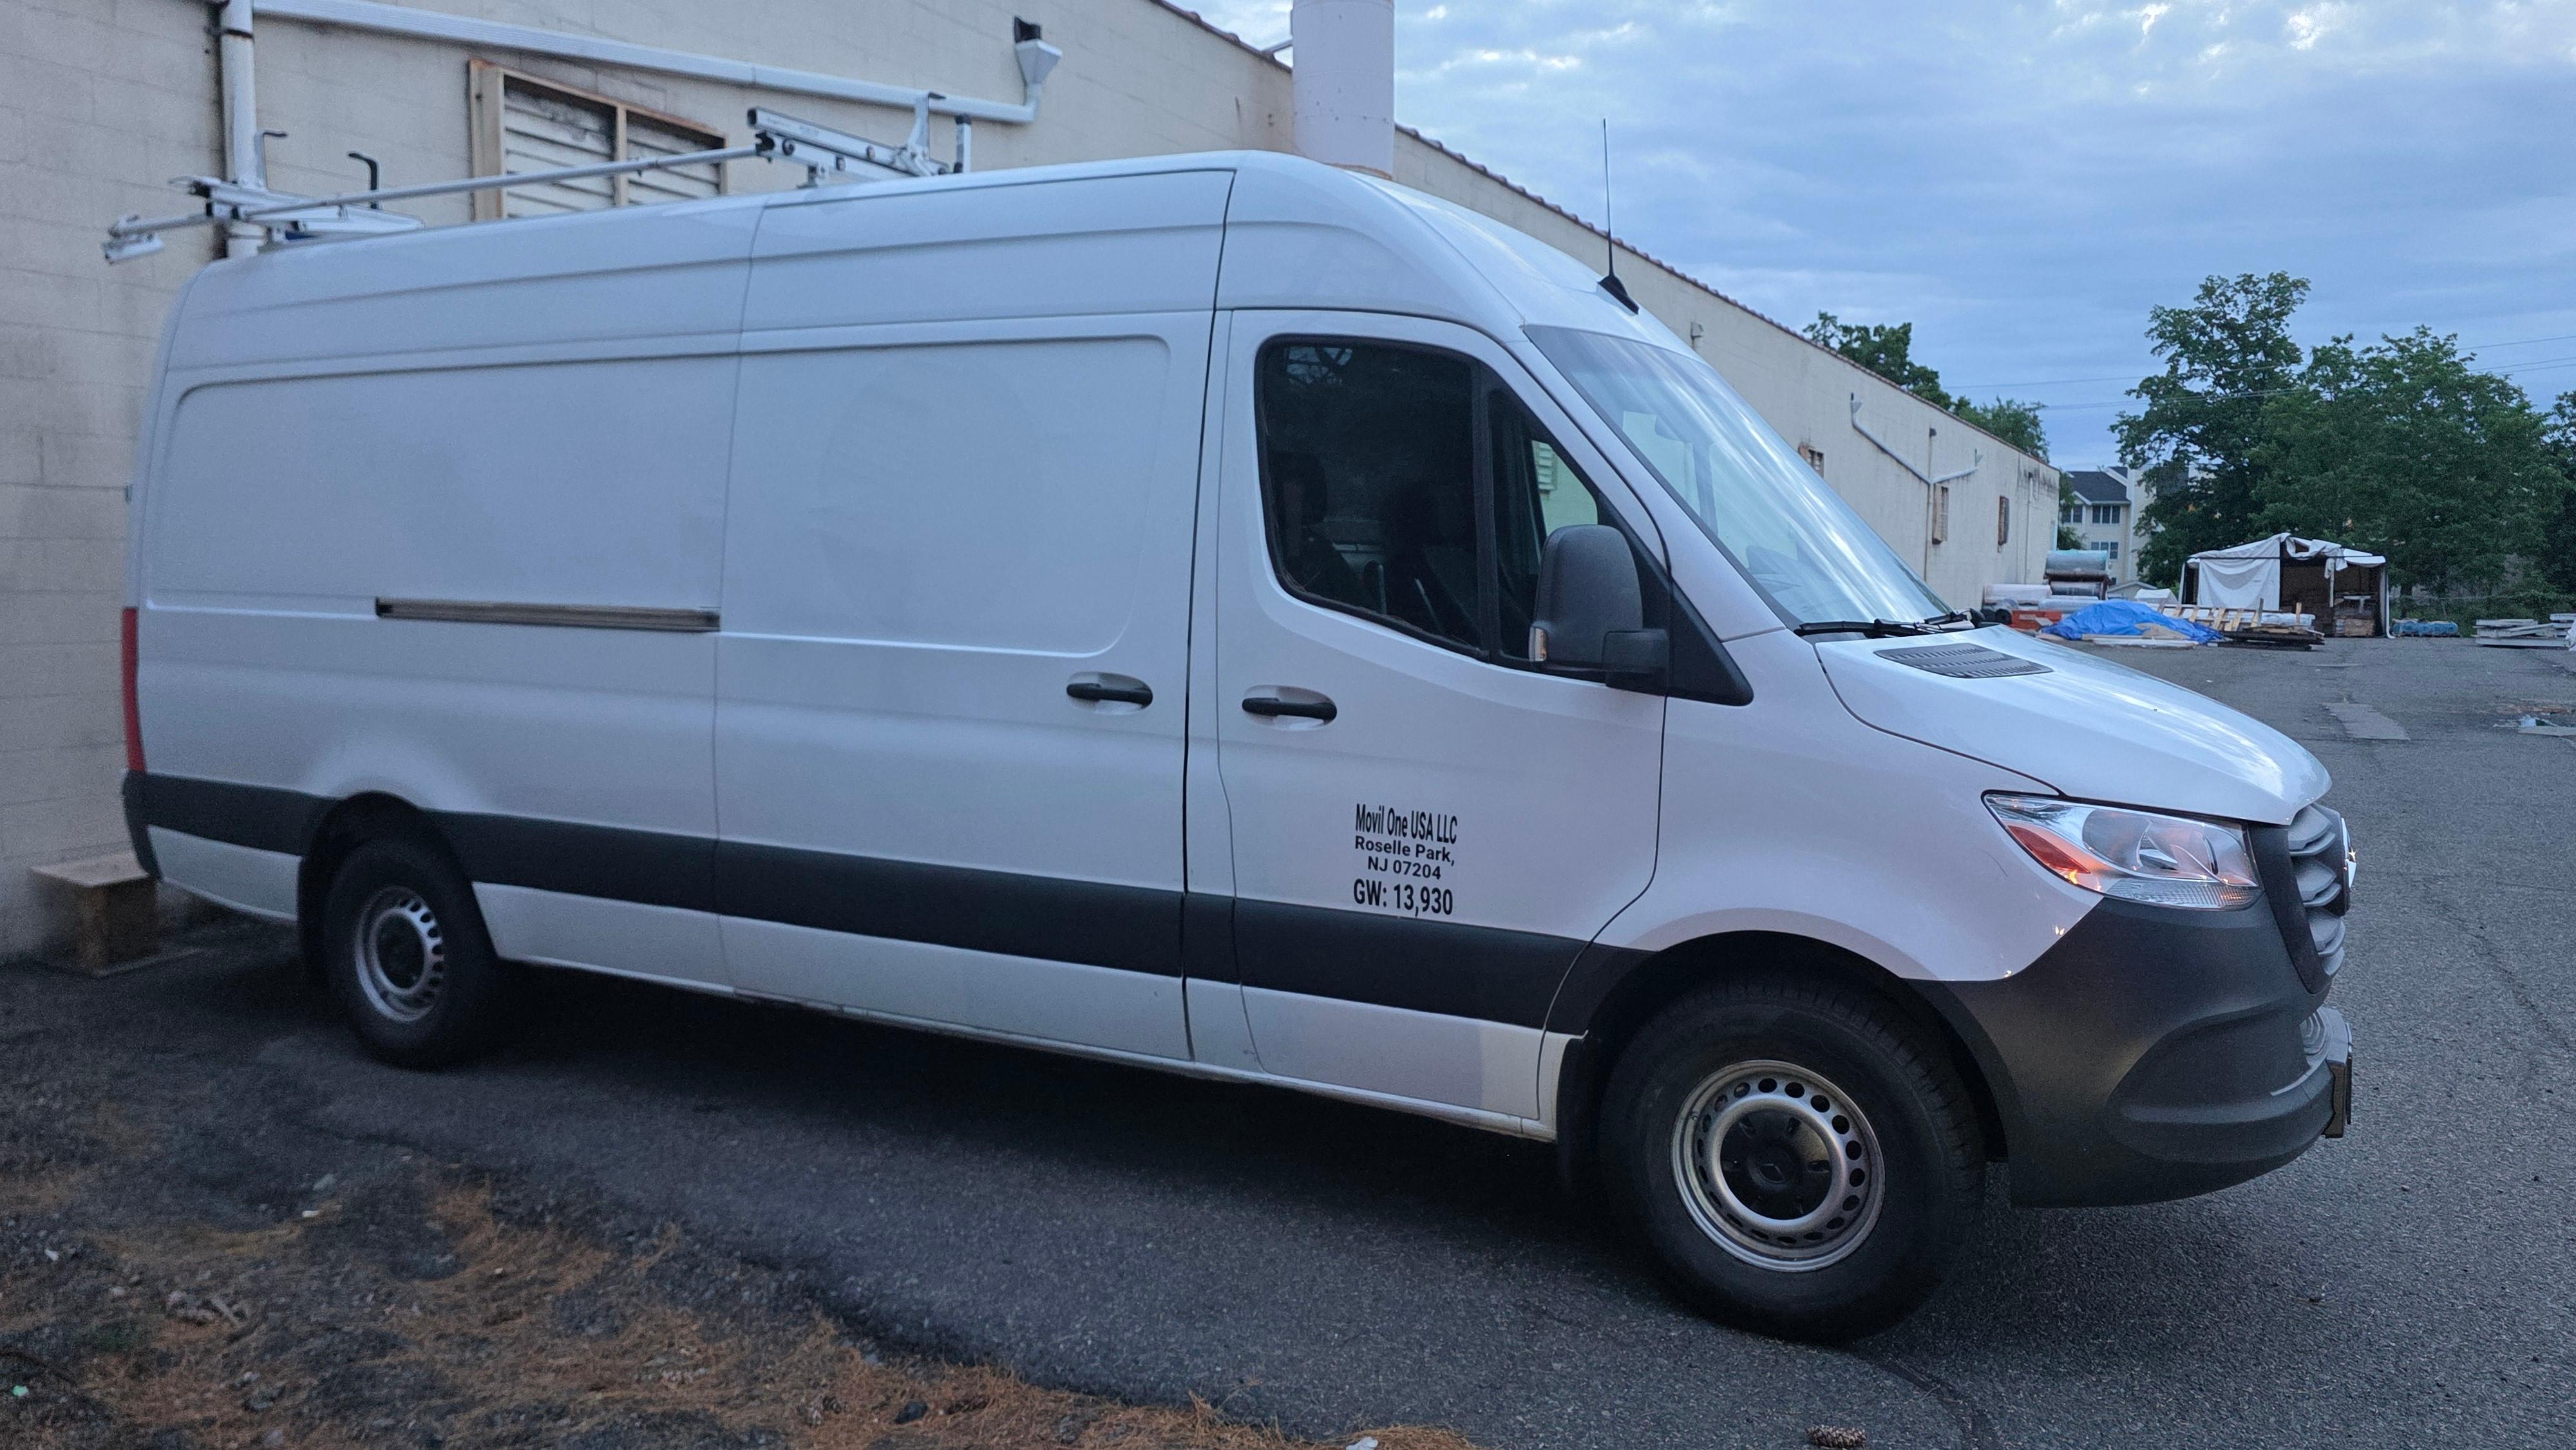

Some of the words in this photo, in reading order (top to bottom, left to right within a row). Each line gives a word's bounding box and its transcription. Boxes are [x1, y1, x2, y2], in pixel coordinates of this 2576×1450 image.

[1356, 803, 1385, 834] Movil
[1387, 807, 1408, 837] One
[1411, 810, 1434, 841] USA
[1437, 814, 1457, 844] LLC
[1355, 835, 1411, 856] Roselle
[1416, 843, 1455, 866] Park,
[1368, 856, 1388, 872] NJ
[1392, 859, 1441, 880] 07204
[1354, 878, 1387, 907] GW:
[1394, 883, 1453, 917] 13,930
